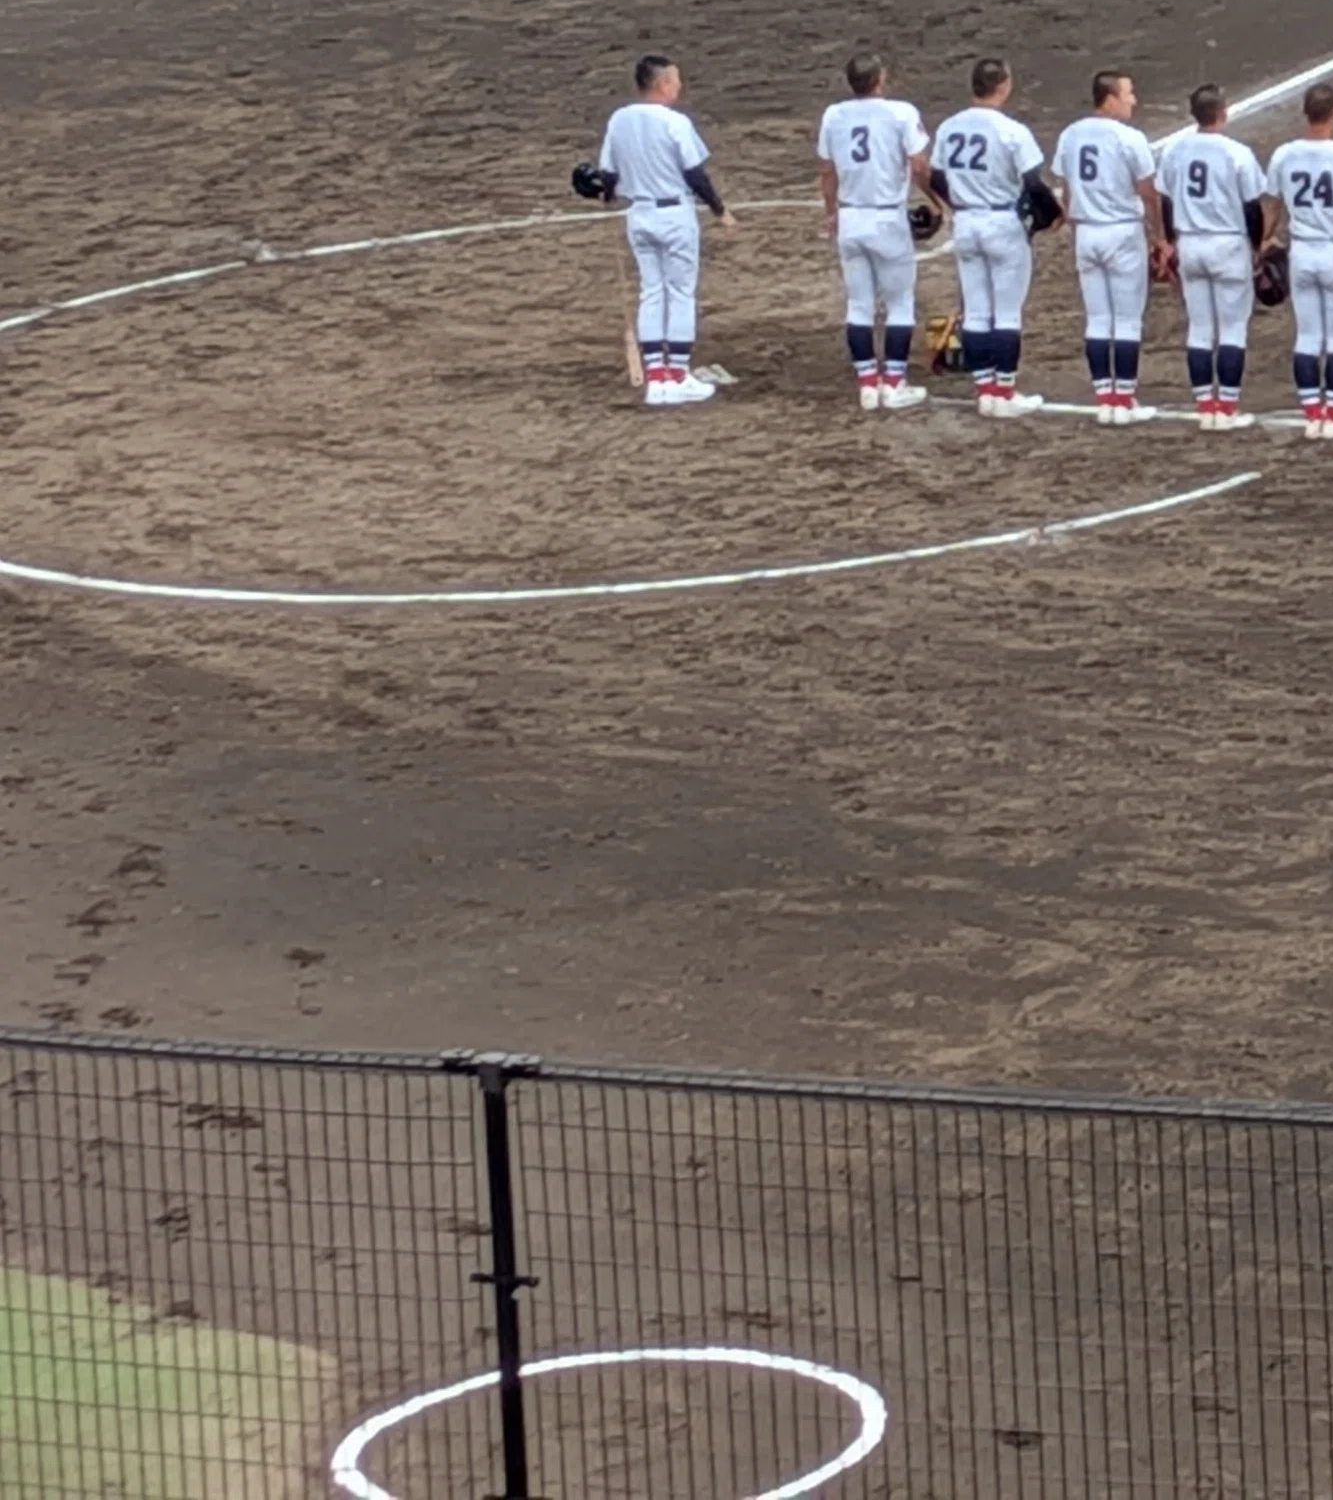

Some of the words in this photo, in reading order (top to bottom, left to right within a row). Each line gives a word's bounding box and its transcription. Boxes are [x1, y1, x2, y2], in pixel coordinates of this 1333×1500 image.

[851, 126, 870, 163] 3
[948, 133, 987, 172] 22
[1079, 146, 1098, 181] 6
[1187, 161, 1208, 198] 9
